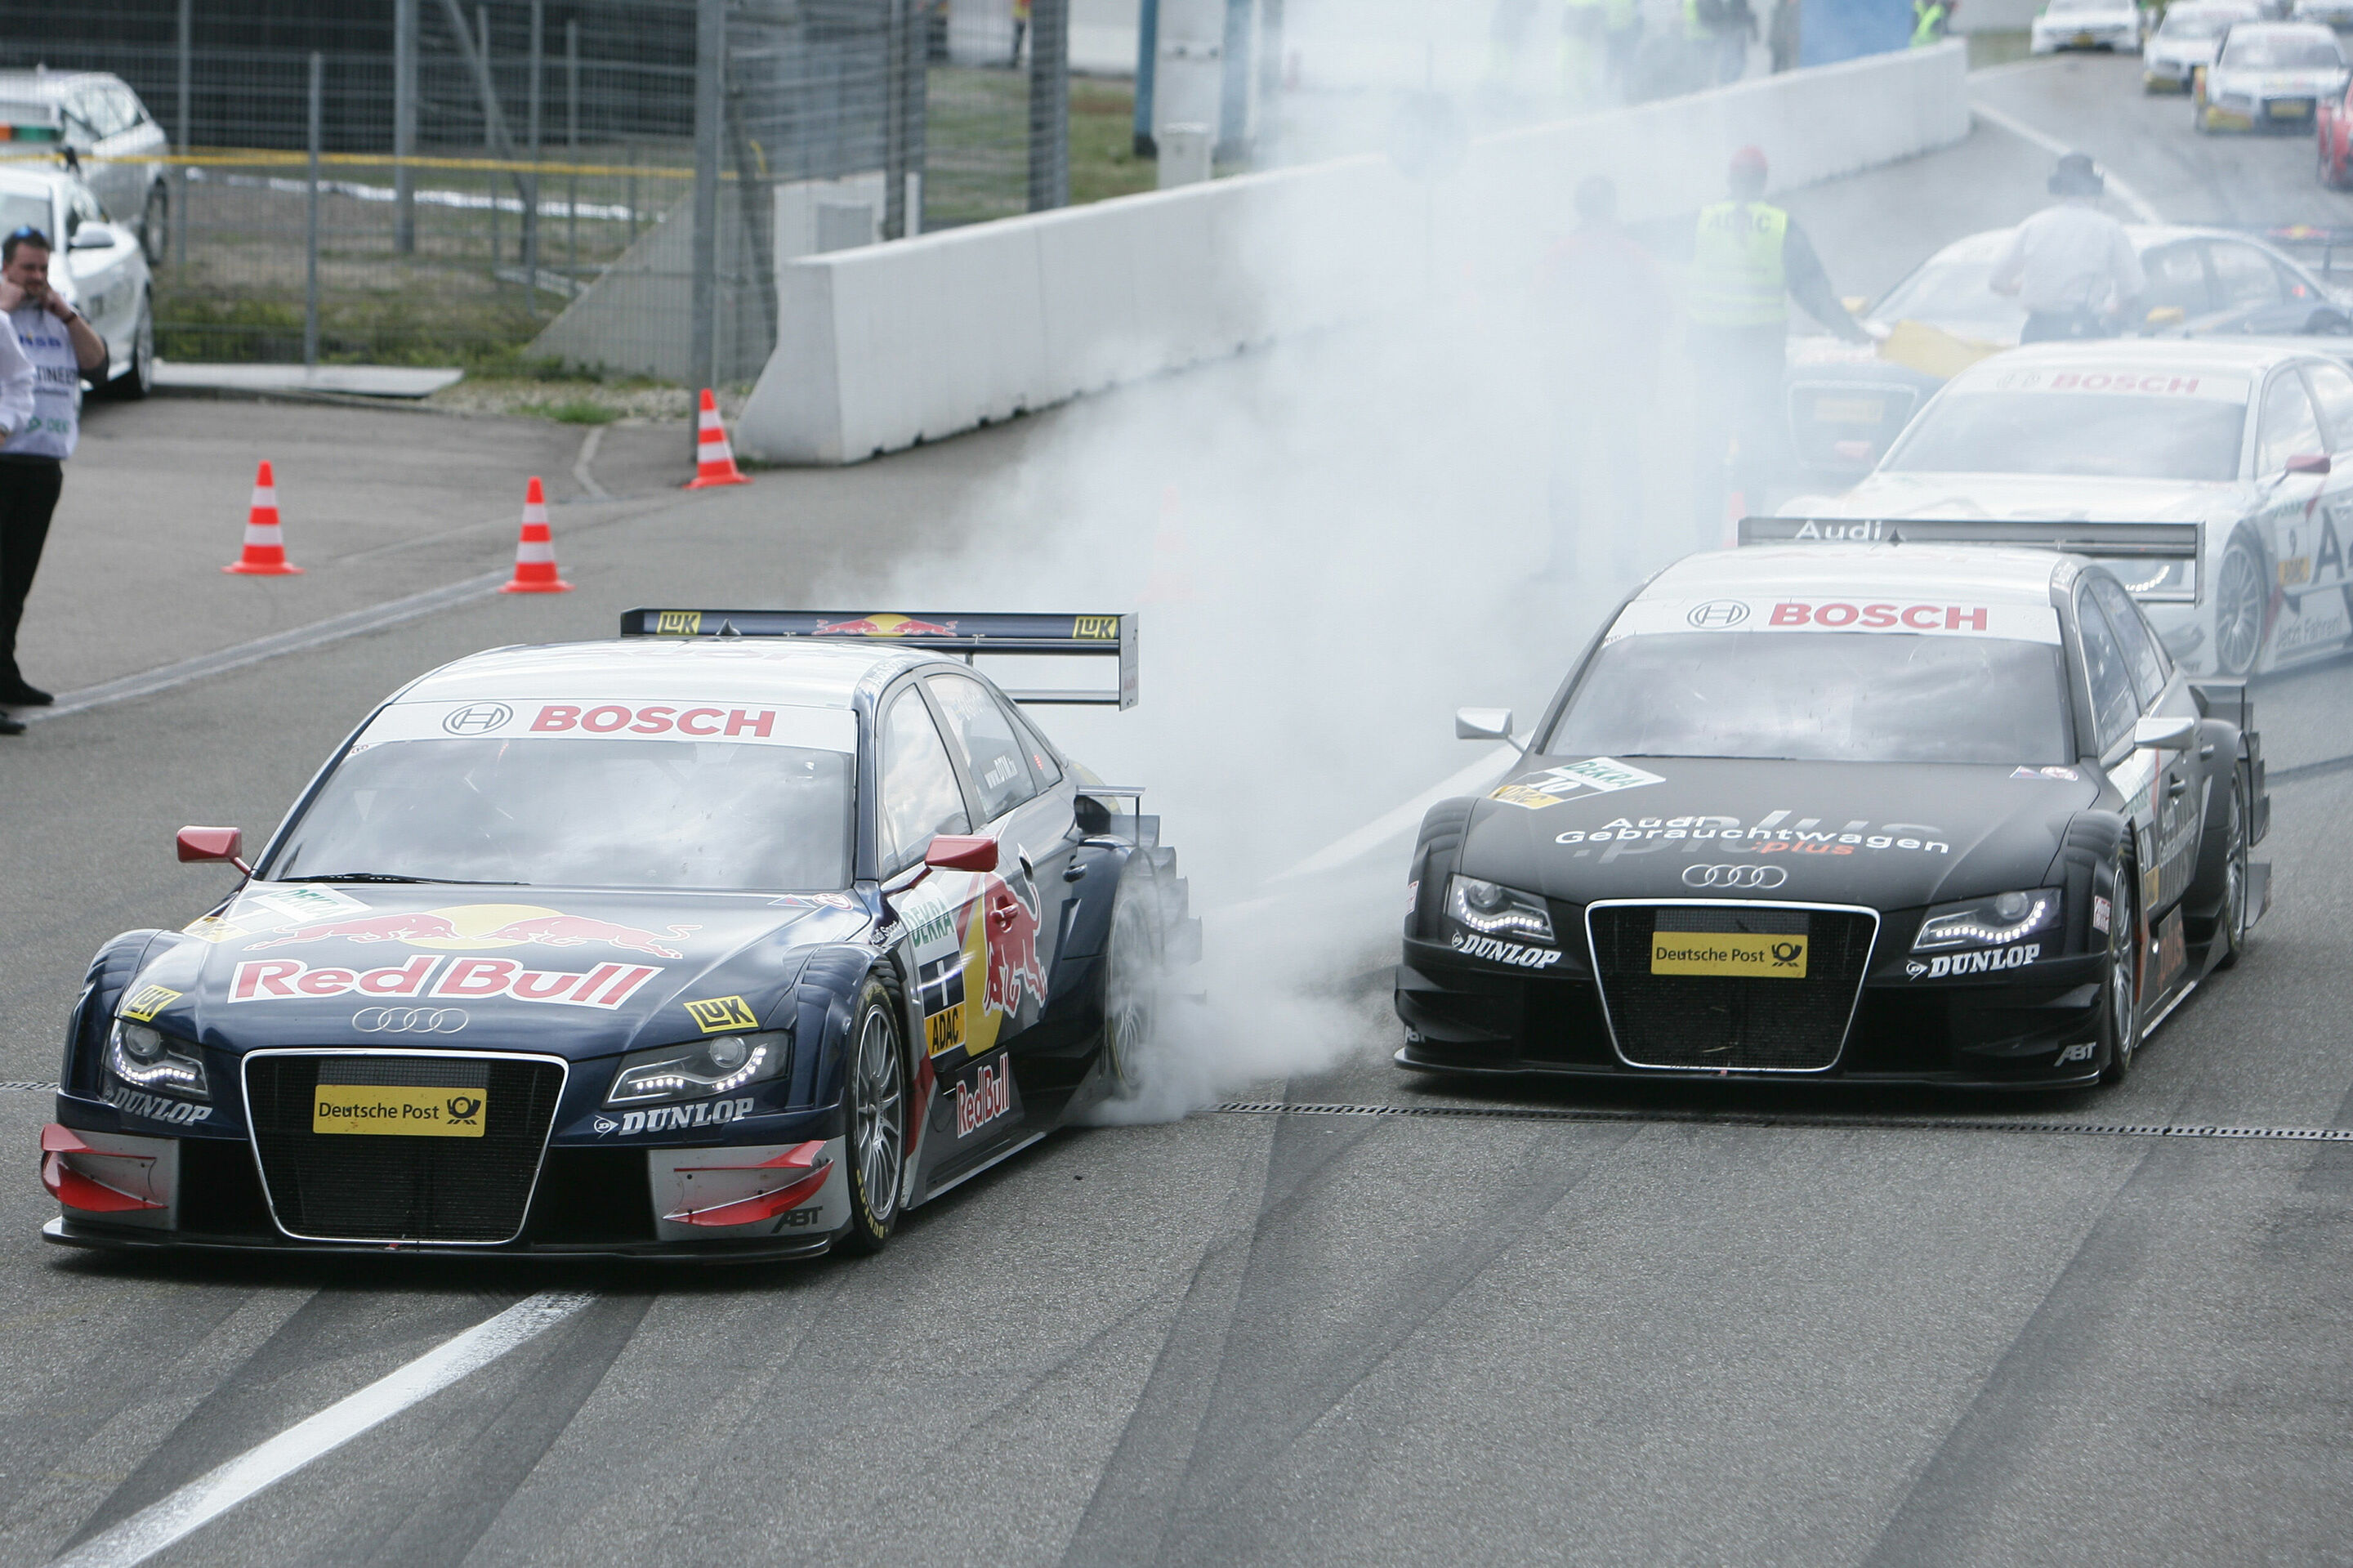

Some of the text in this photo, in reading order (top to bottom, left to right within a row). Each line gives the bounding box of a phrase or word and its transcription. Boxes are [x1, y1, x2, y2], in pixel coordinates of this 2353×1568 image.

[2052, 373, 2200, 394] BOSCH
[1795, 520, 1882, 540] Audi
[1768, 603, 1989, 631] BOSCH
[529, 705, 776, 737] BOSCH
[1526, 776, 1583, 794] 10
[1601, 815, 1708, 831] Audi
[1555, 826, 1950, 854] Gebrauchtwagen
[1458, 933, 1562, 969] DUNLOP
[1656, 945, 1766, 963] Deutsche Post
[1928, 944, 2041, 979] DUNLOP
[228, 954, 666, 1010] Red Bull
[931, 1007, 960, 1054] ADAC
[2054, 1041, 2096, 1067] ABT
[114, 1087, 213, 1126] DUNLOP
[956, 1065, 985, 1139] Red
[983, 1051, 1010, 1123] Bull
[319, 1101, 440, 1119] Deutsche Post
[618, 1097, 754, 1136] DUNLOP
[770, 1205, 824, 1235] ABT
